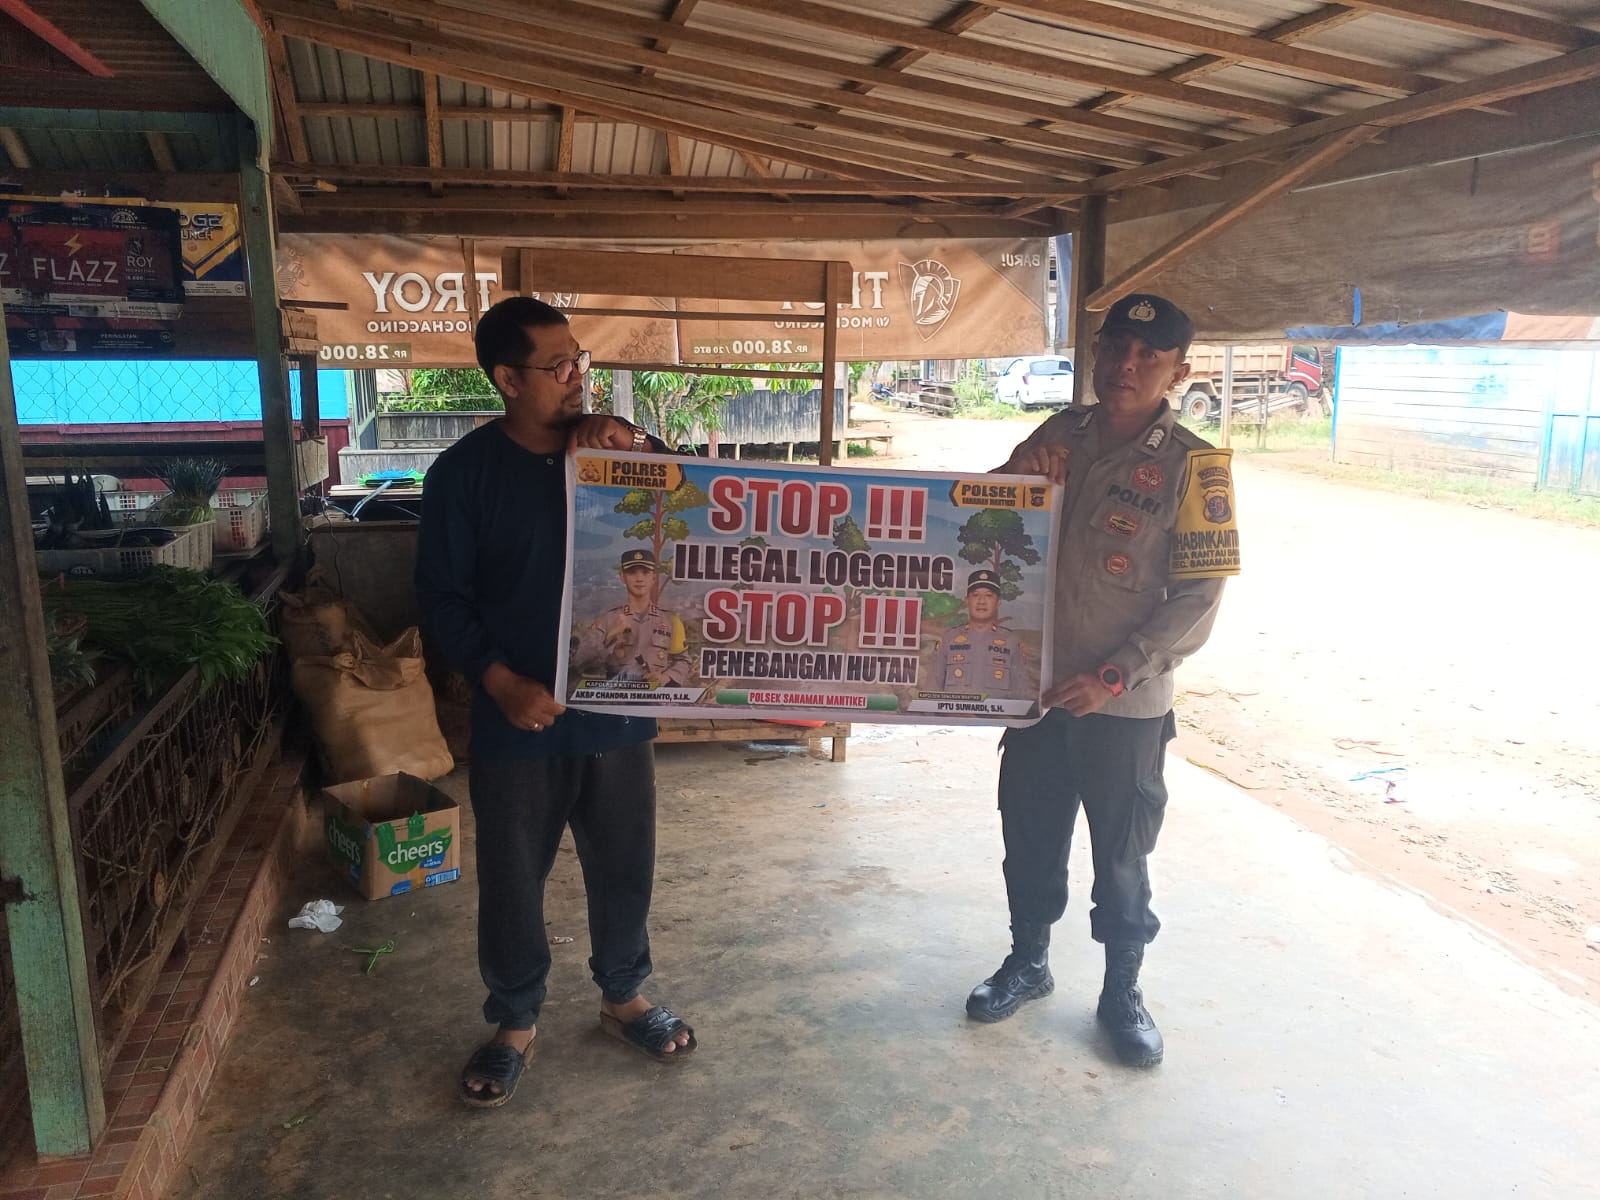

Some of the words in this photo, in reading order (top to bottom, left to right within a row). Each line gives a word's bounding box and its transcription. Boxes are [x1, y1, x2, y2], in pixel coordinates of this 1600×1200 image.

[33, 257, 119, 284] FLAZZ
[611, 461, 667, 477] POLRES
[611, 475, 667, 488] KATINGAN
[962, 484, 1017, 498] POLSEK
[1107, 484, 1161, 515] POLRI
[709, 477, 851, 538] STOP
[867, 485, 928, 543] !!!
[674, 543, 801, 584] ILLEGAL
[810, 550, 955, 592] LOGGING
[704, 589, 845, 645] STOP
[860, 597, 921, 649] !!!
[701, 649, 842, 681] PENEBANGAN
[847, 653, 918, 684] HUTAN
[576, 690, 594, 699] AKBP
[595, 691, 628, 700] CHANDRA
[750, 692, 780, 704] POLSEK
[826, 695, 866, 707] MANTIKEI
[937, 702, 954, 711] IPTU
[955, 703, 989, 713] SUWARDI,
[329, 818, 361, 865] cheers
[387, 840, 444, 865] cheers
